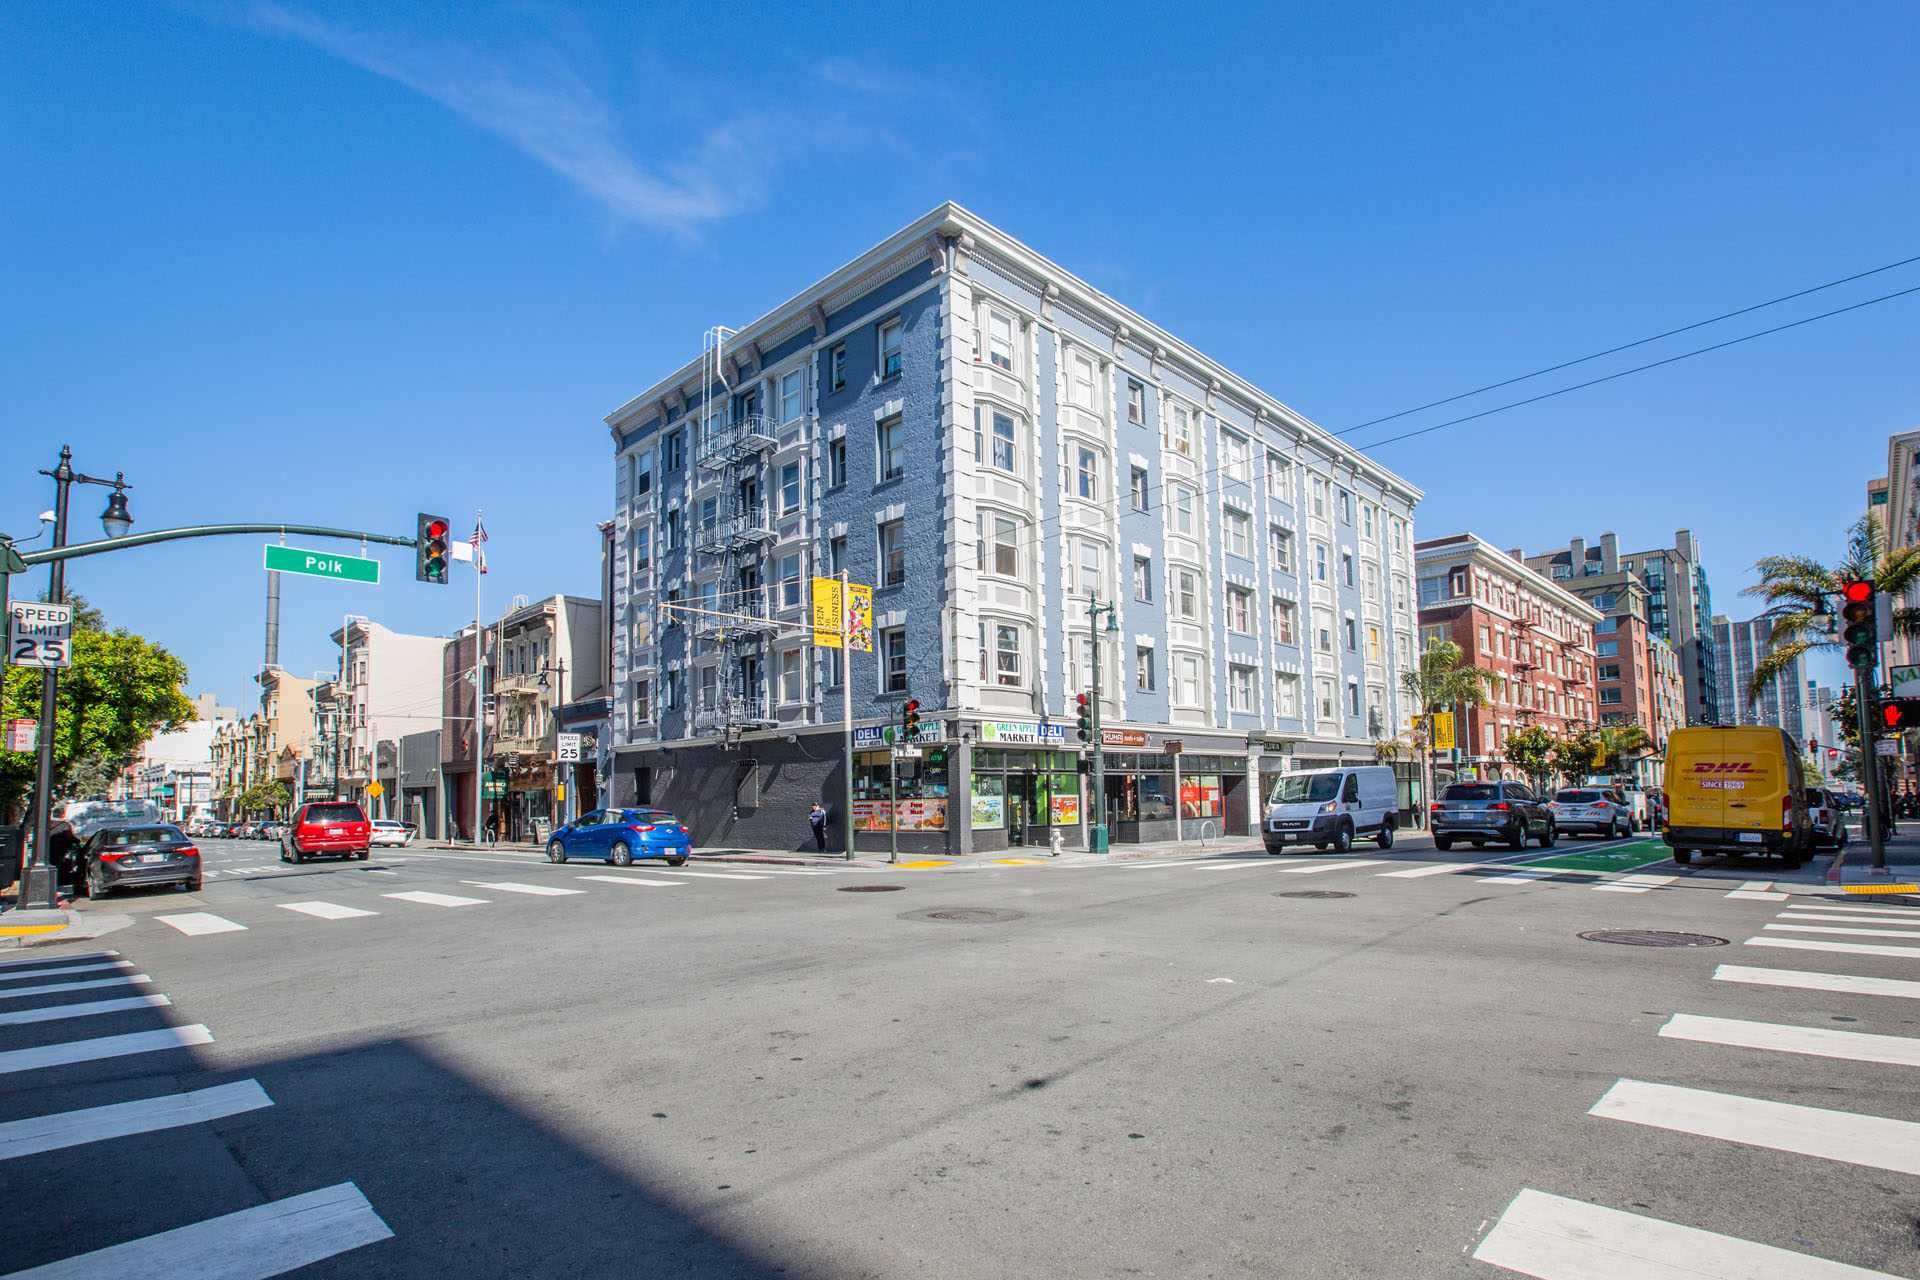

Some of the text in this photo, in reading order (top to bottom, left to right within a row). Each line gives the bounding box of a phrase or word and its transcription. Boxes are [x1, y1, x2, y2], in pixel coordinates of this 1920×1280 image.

[306, 556, 343, 573] Polk
[14, 608, 69, 622] SPEED
[18, 623, 63, 636] LIMIT
[14, 639, 65, 661] 25
[1893, 667, 1920, 686] NA
[997, 723, 1036, 732] GREEN APPLE
[1041, 726, 1062, 736] DELI
[857, 728, 879, 739] DELI
[1000, 733, 1034, 742] MARKET
[560, 749, 578, 758] 25
[1693, 763, 1755, 773] DHL
